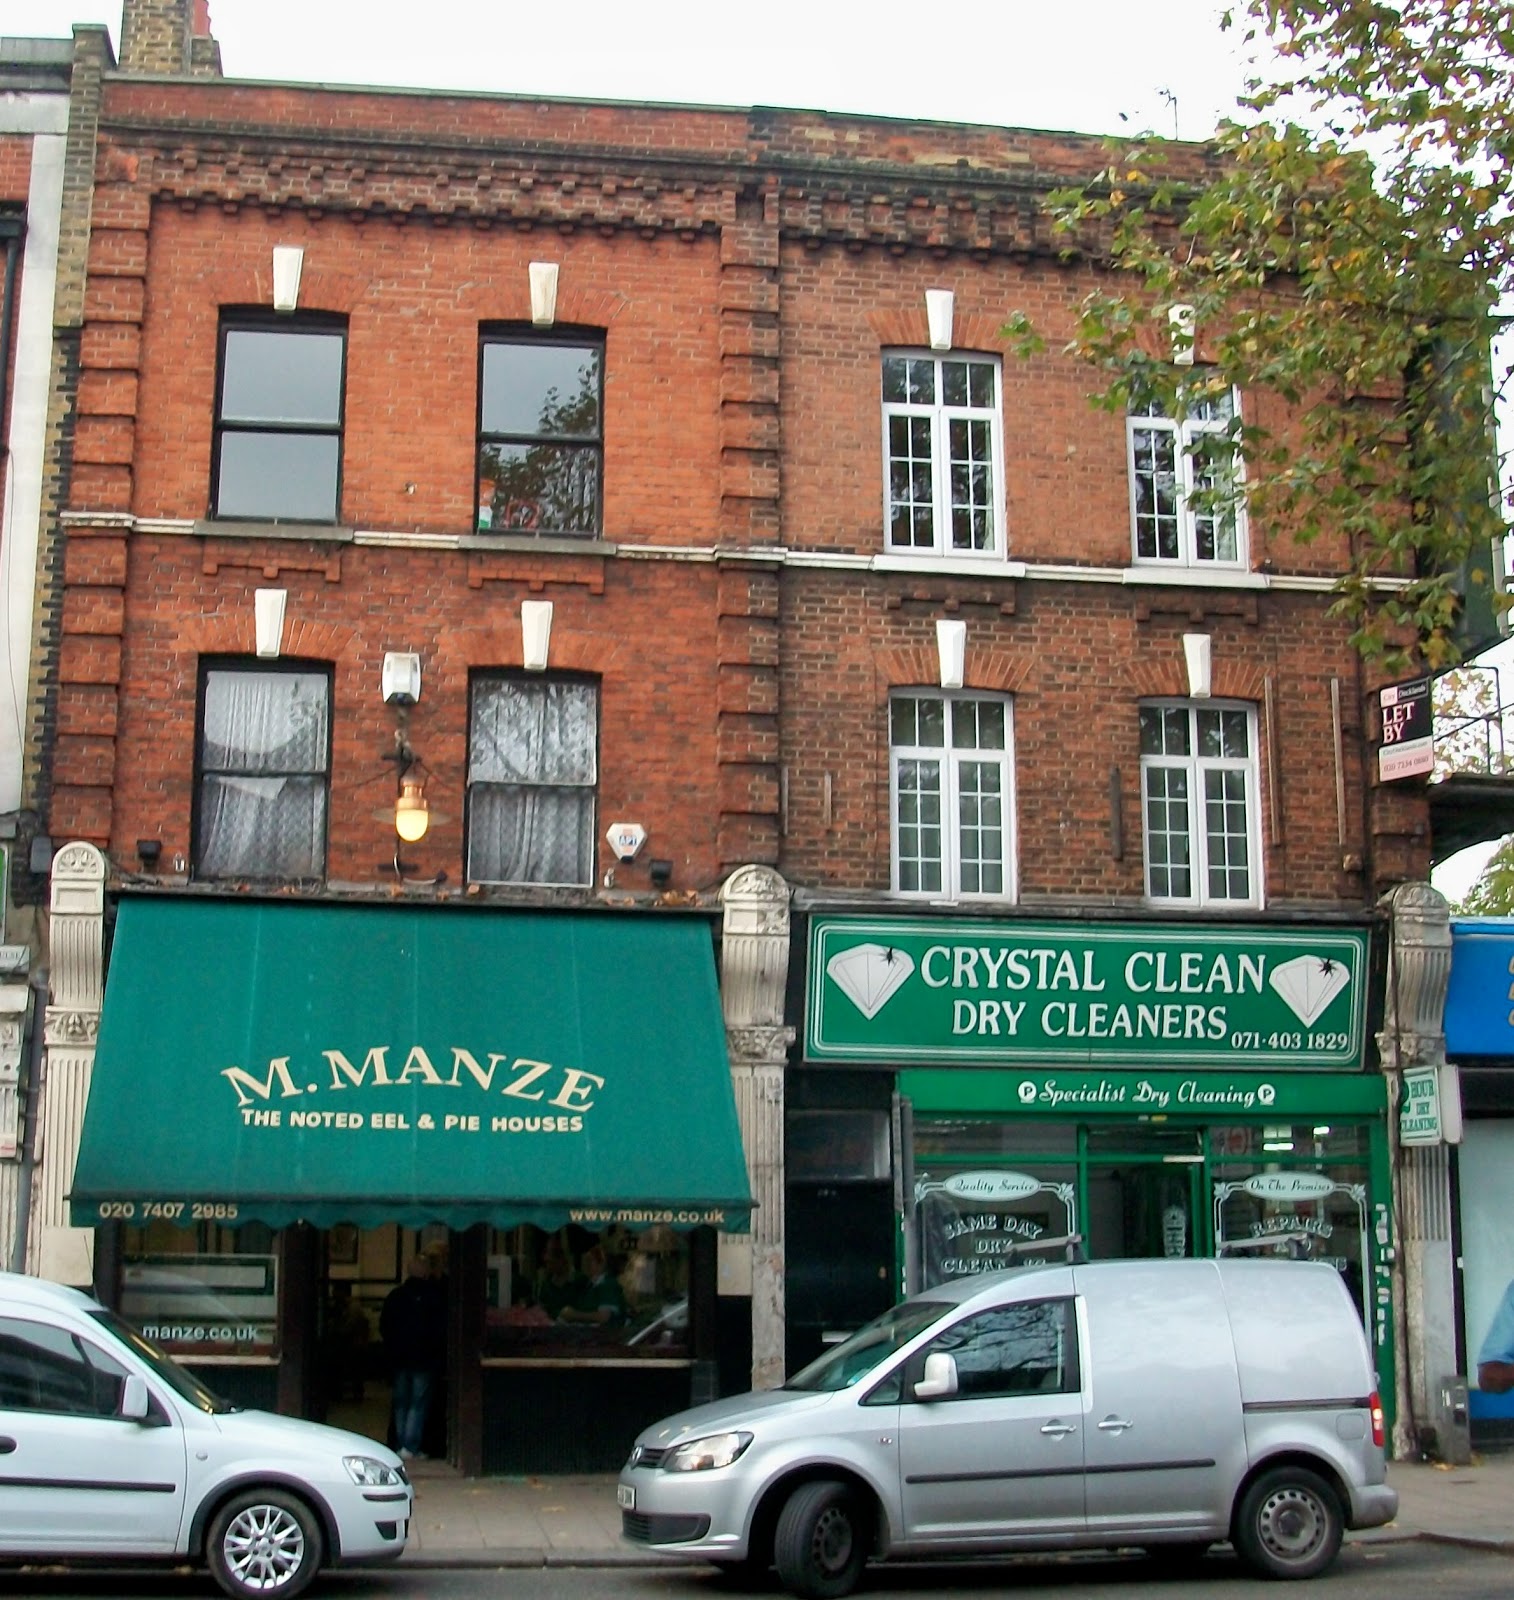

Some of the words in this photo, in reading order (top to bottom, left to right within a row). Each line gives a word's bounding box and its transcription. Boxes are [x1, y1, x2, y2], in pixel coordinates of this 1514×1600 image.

[1382, 702, 1414, 724] LET
[1383, 722, 1404, 743] BY
[920, 945, 1105, 991] CRYSTAL
[1124, 951, 1267, 995] CLEAN
[952, 999, 1027, 1036] DRY
[1040, 1003, 1228, 1039] CLEANERS
[1305, 1031, 1349, 1050] 1829
[1039, 1079, 1126, 1107] Specialist
[1132, 1080, 1169, 1108] Dry
[1177, 1081, 1255, 1109] Cleaning
[241, 1108, 281, 1127] THE
[289, 1110, 364, 1128] NOTED
[371, 1113, 410, 1130] EEL
[417, 1114, 435, 1130] &
[444, 1114, 480, 1131] PIE
[491, 1115, 584, 1132] HOUSES
[954, 1179, 995, 1193] Quality
[998, 1180, 1035, 1191] Service
[1250, 1180, 1264, 1190] On
[1268, 1179, 1287, 1191] The
[1290, 1179, 1331, 1191] Premises
[99, 1202, 134, 1219] 020
[142, 1202, 185, 1219] 7407
[191, 1203, 238, 1219] 2985
[569, 1209, 725, 1223] www.manze.co.uk
[944, 1213, 998, 1240] SAME
[1003, 1215, 1044, 1240] DAY
[1251, 1215, 1333, 1238] REPAIRS
[975, 1239, 1014, 1254] DRY
[142, 1324, 258, 1340] manze.co.uk
